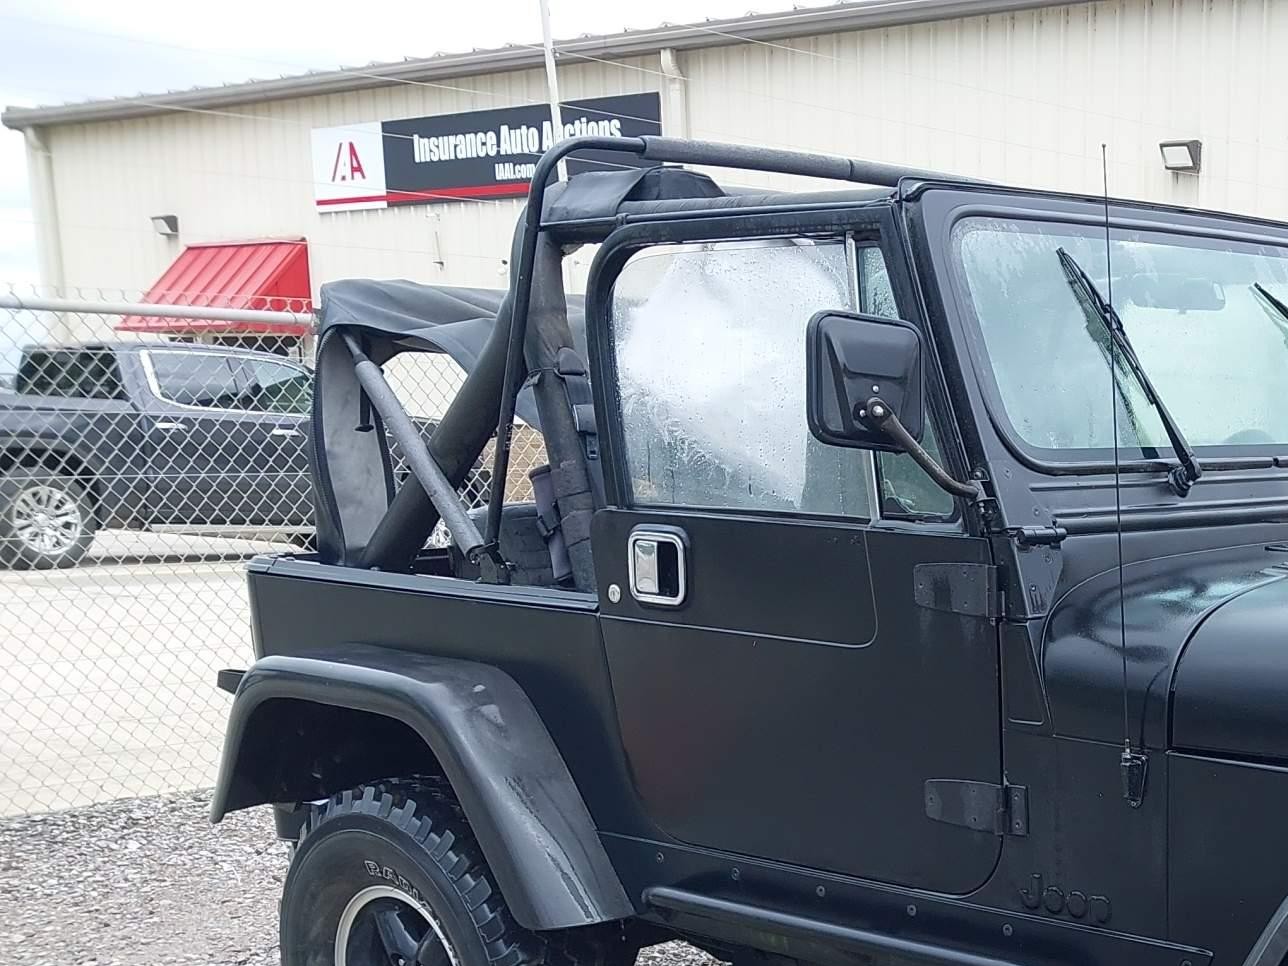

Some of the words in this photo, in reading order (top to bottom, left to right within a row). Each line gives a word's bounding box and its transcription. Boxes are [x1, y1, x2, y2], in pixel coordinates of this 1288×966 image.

[413, 134, 497, 163] Insurance
[500, 125, 540, 155] Auto
[542, 117, 622, 151] Actions
